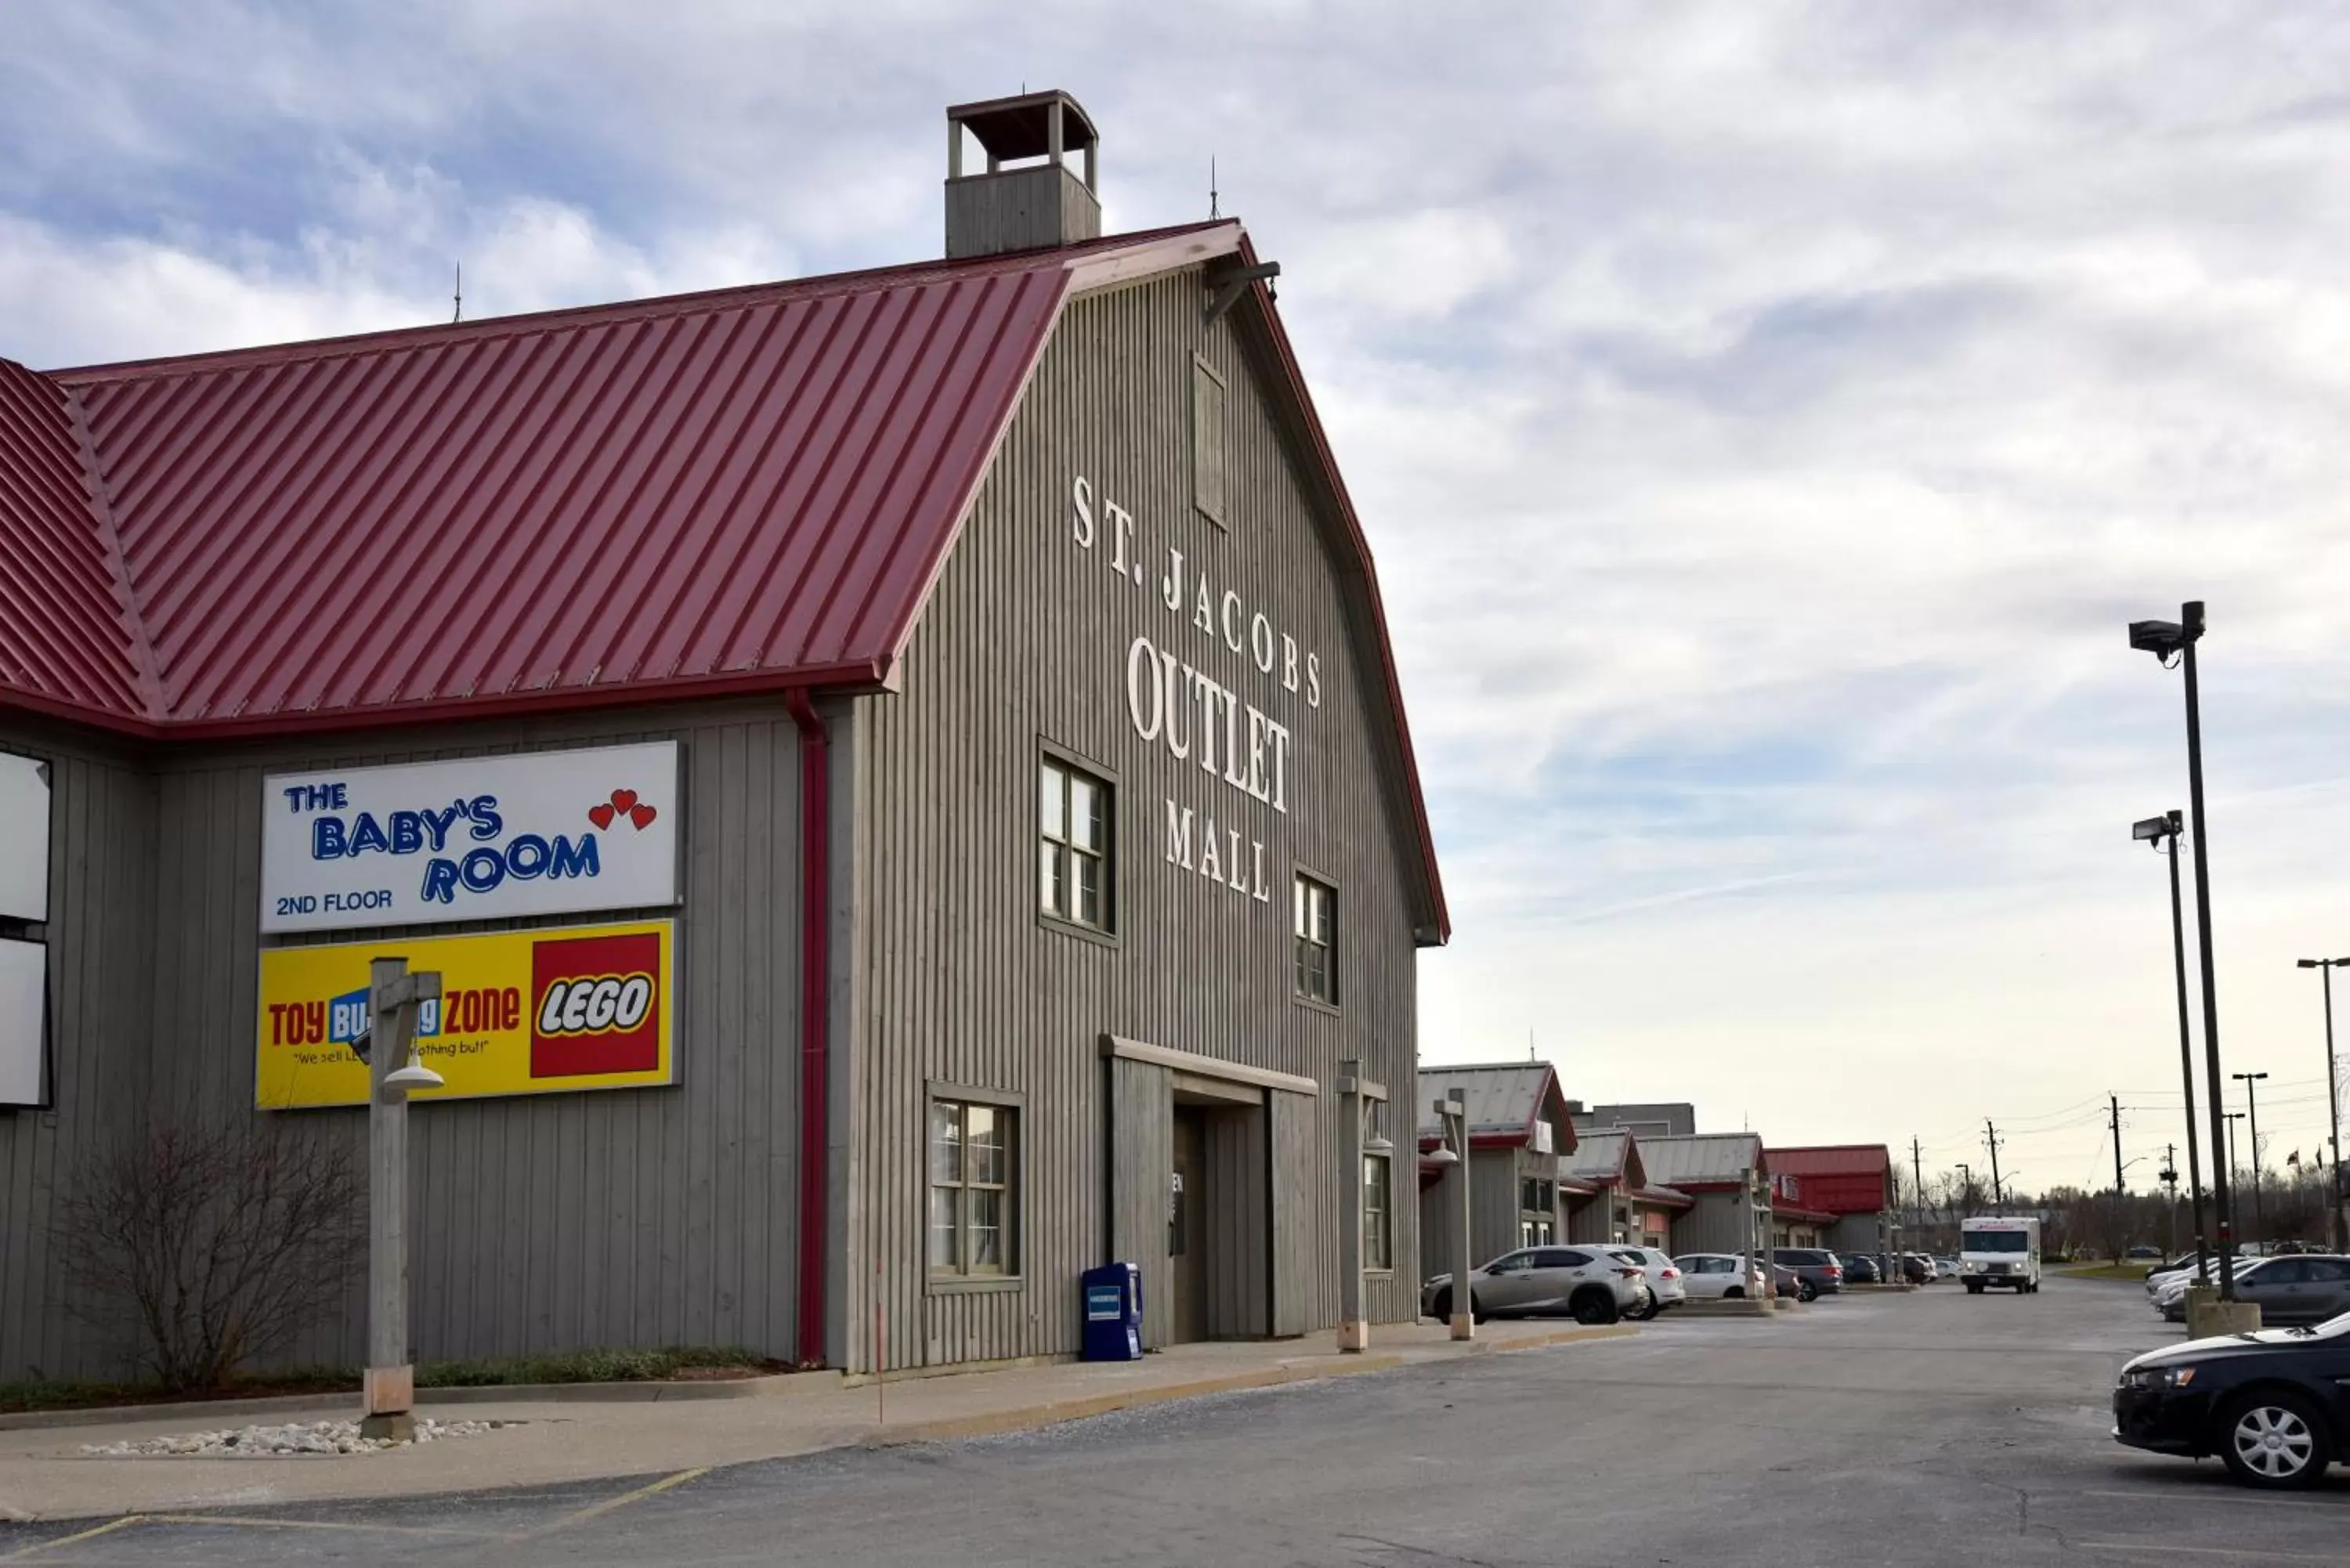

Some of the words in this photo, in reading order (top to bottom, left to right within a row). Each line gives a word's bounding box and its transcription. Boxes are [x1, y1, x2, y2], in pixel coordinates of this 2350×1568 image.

[1072, 475, 1144, 587] ST.
[1162, 547, 1321, 709] JACOBS
[1127, 636, 1290, 814] OUTLET
[284, 782, 349, 814] THE
[312, 795, 503, 861] BABY'S
[421, 833, 600, 904] ROOM
[1165, 798, 1271, 903] MALL
[277, 895, 317, 916] 2ND
[324, 890, 392, 912] FLOOR
[538, 974, 653, 1035] LEGO
